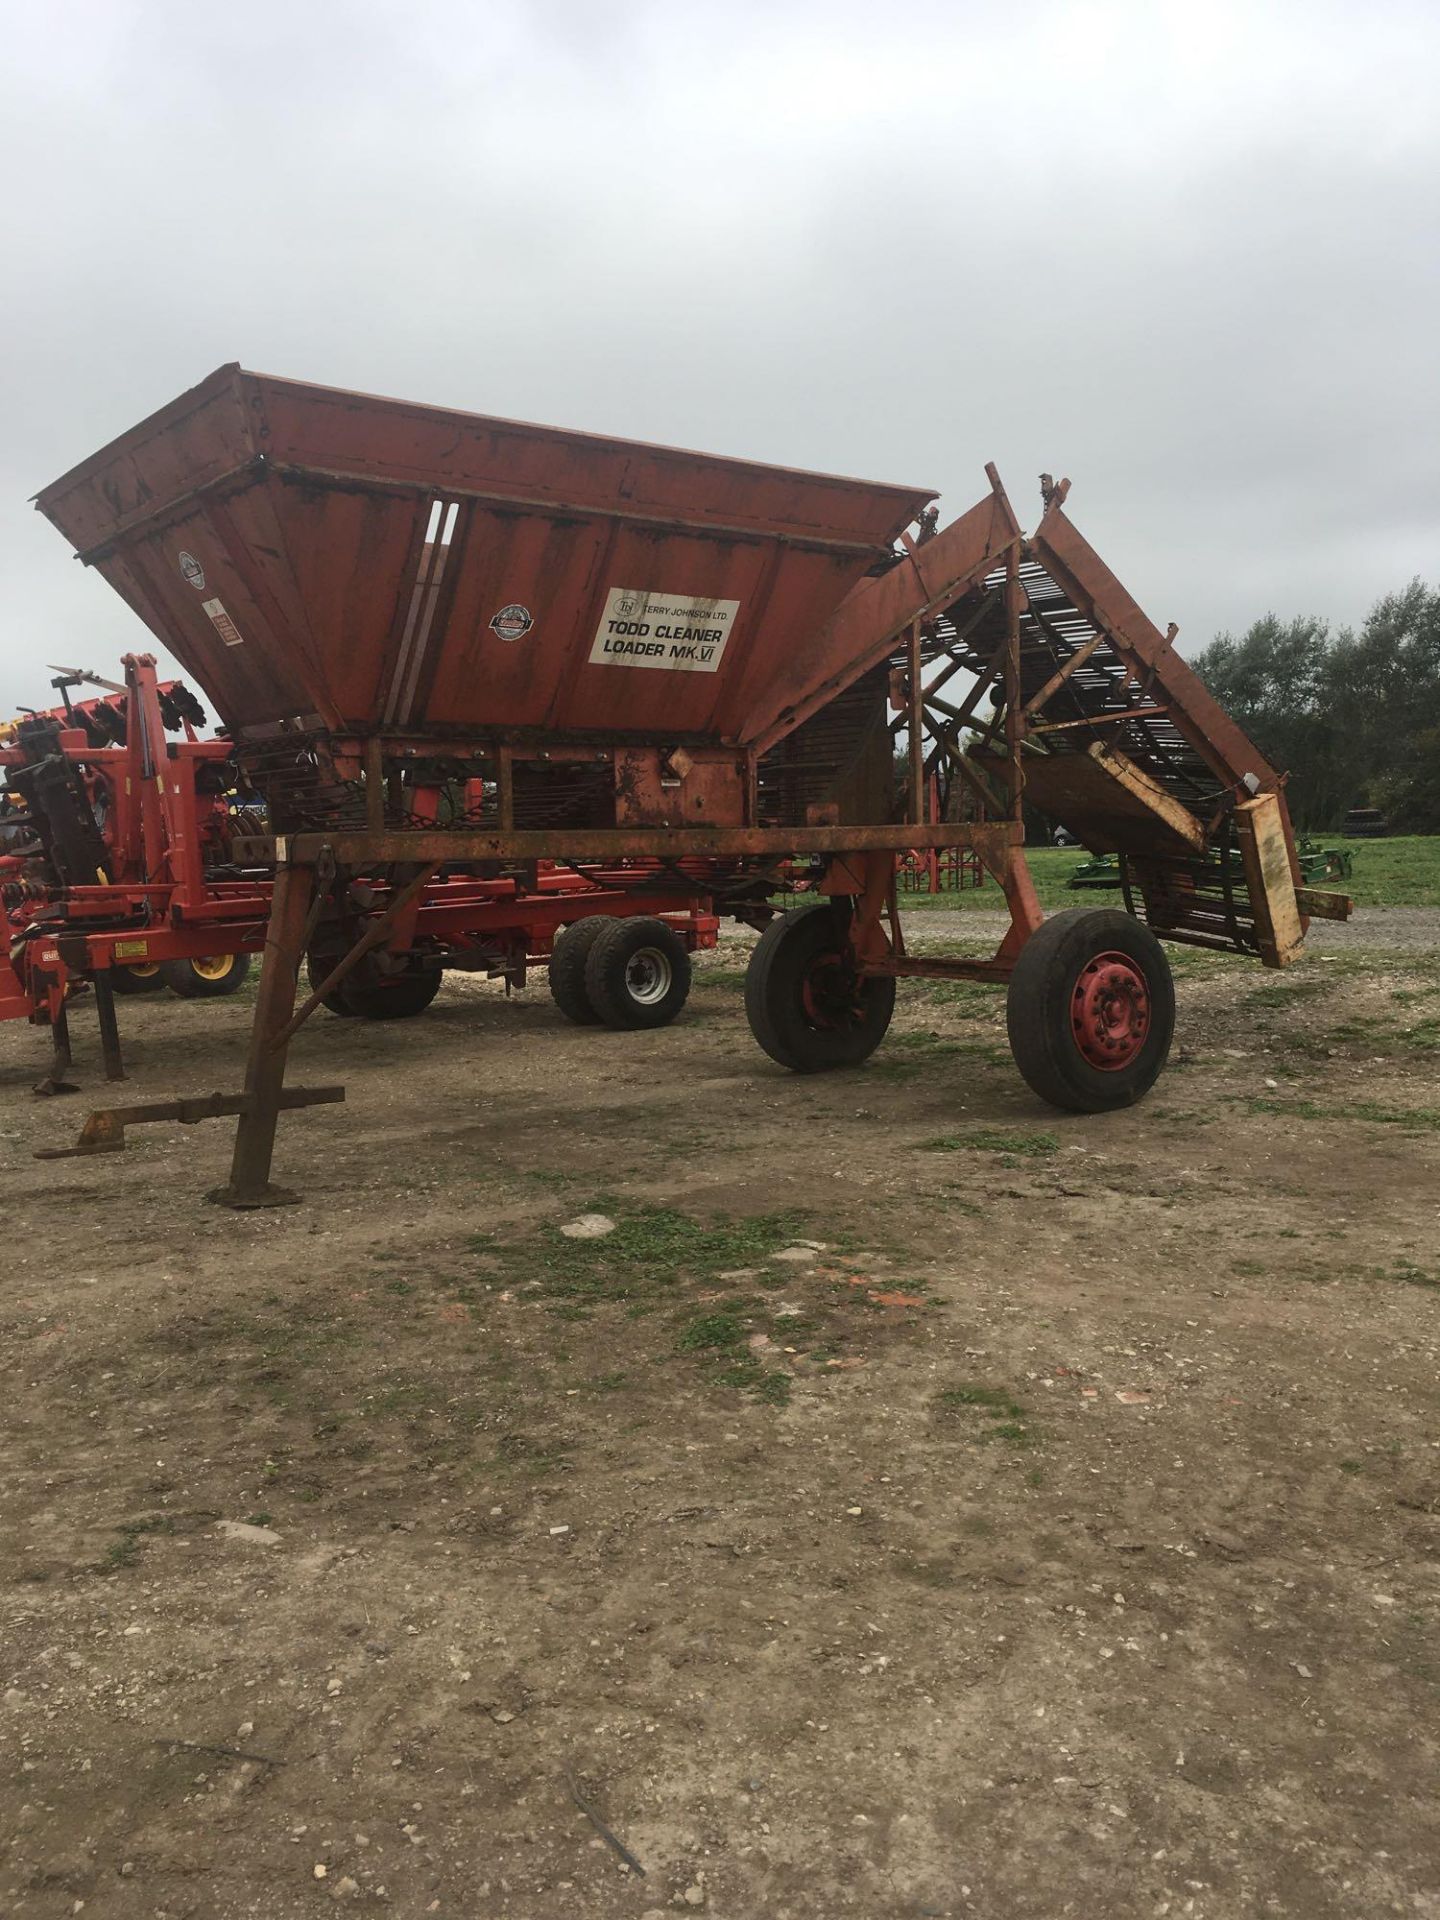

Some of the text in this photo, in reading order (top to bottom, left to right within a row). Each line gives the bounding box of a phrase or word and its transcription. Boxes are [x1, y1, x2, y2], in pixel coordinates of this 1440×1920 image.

[643, 605, 670, 615] TERRY
[671, 608, 711, 619] JOHNSON
[608, 620, 723, 643] TODD CLEANER
[603, 639, 665, 657] LOADER
